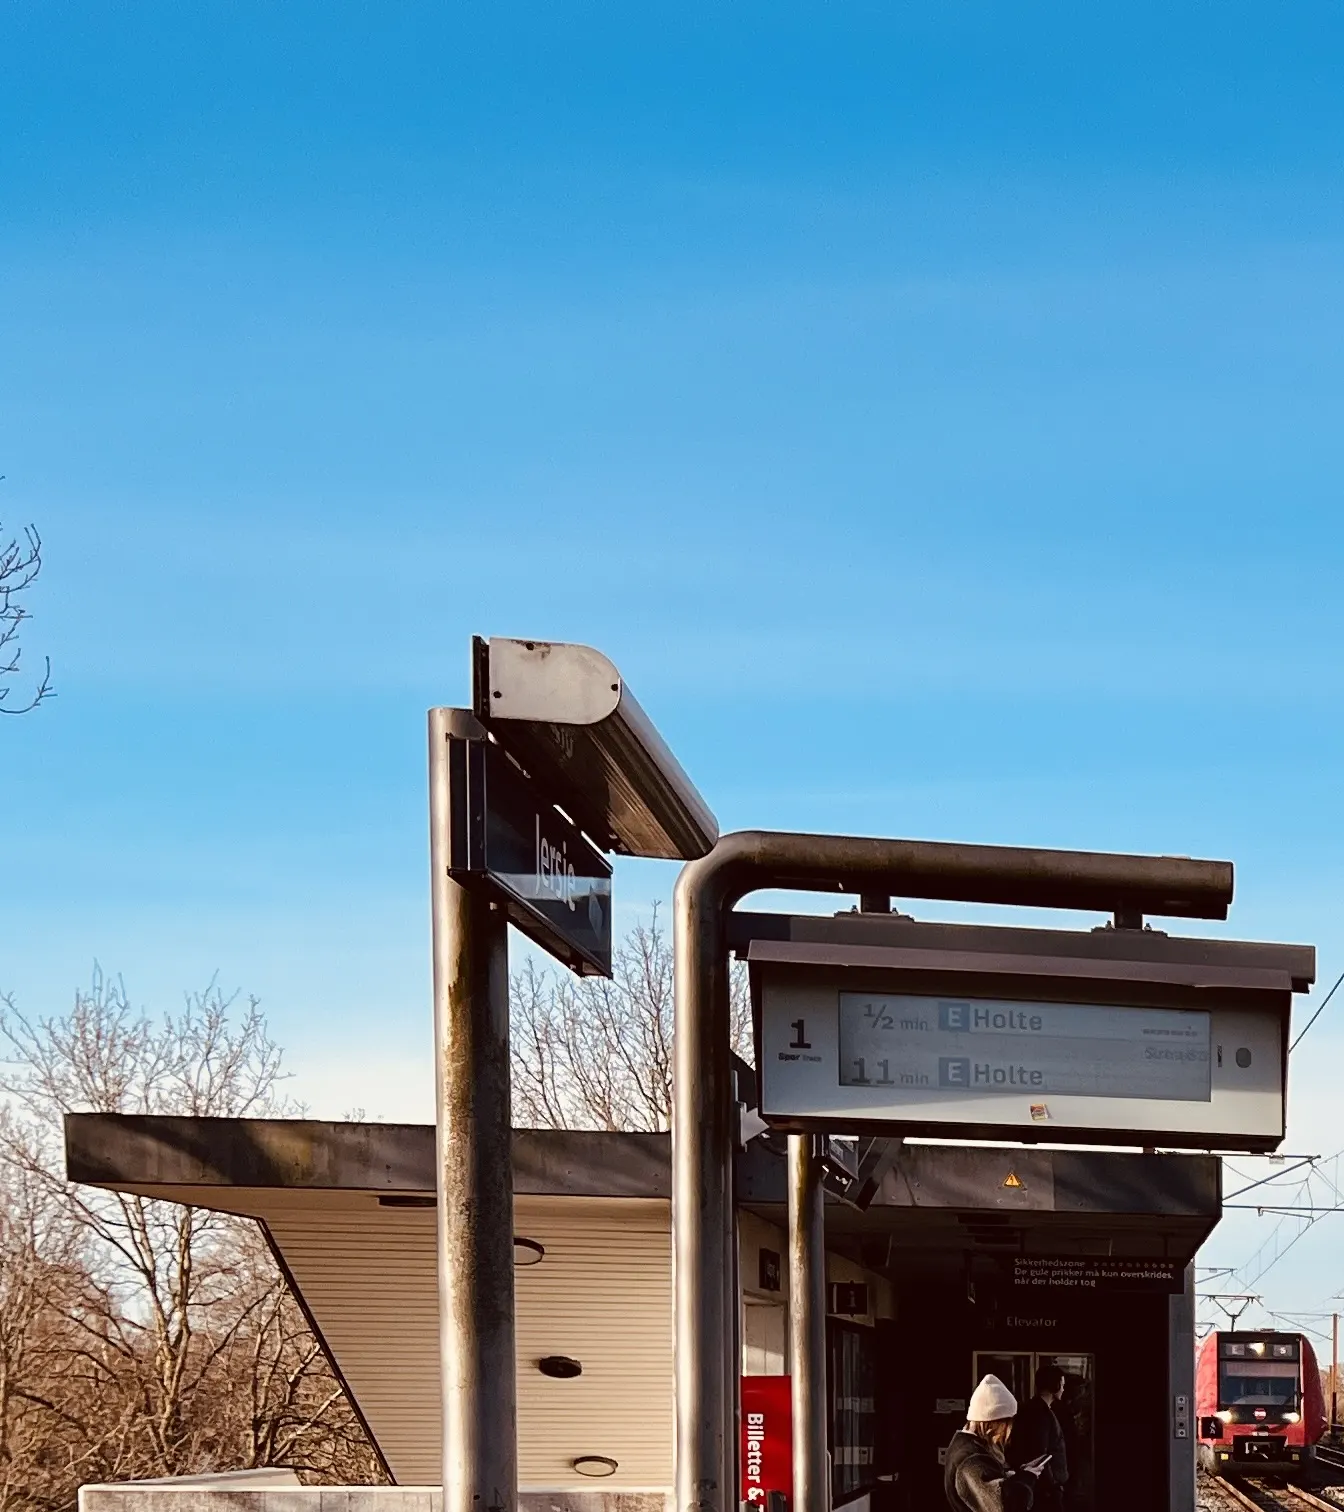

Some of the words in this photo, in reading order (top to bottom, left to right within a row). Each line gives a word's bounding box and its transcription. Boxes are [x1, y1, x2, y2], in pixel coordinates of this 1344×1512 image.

[535, 812, 577, 912] Jersie
[900, 1018, 929, 1032] min
[948, 1007, 962, 1028] E
[974, 1008, 1042, 1031] Holte
[789, 1019, 812, 1049] 1
[851, 1057, 895, 1085] 11
[900, 1070, 929, 1085] min
[948, 1062, 962, 1082] E
[974, 1063, 1043, 1086] Holte
[1080, 1279, 1096, 1287] tog
[1006, 1316, 1058, 1327] Elevator
[747, 1413, 765, 1484] Billetter
[747, 1487, 765, 1501] &
